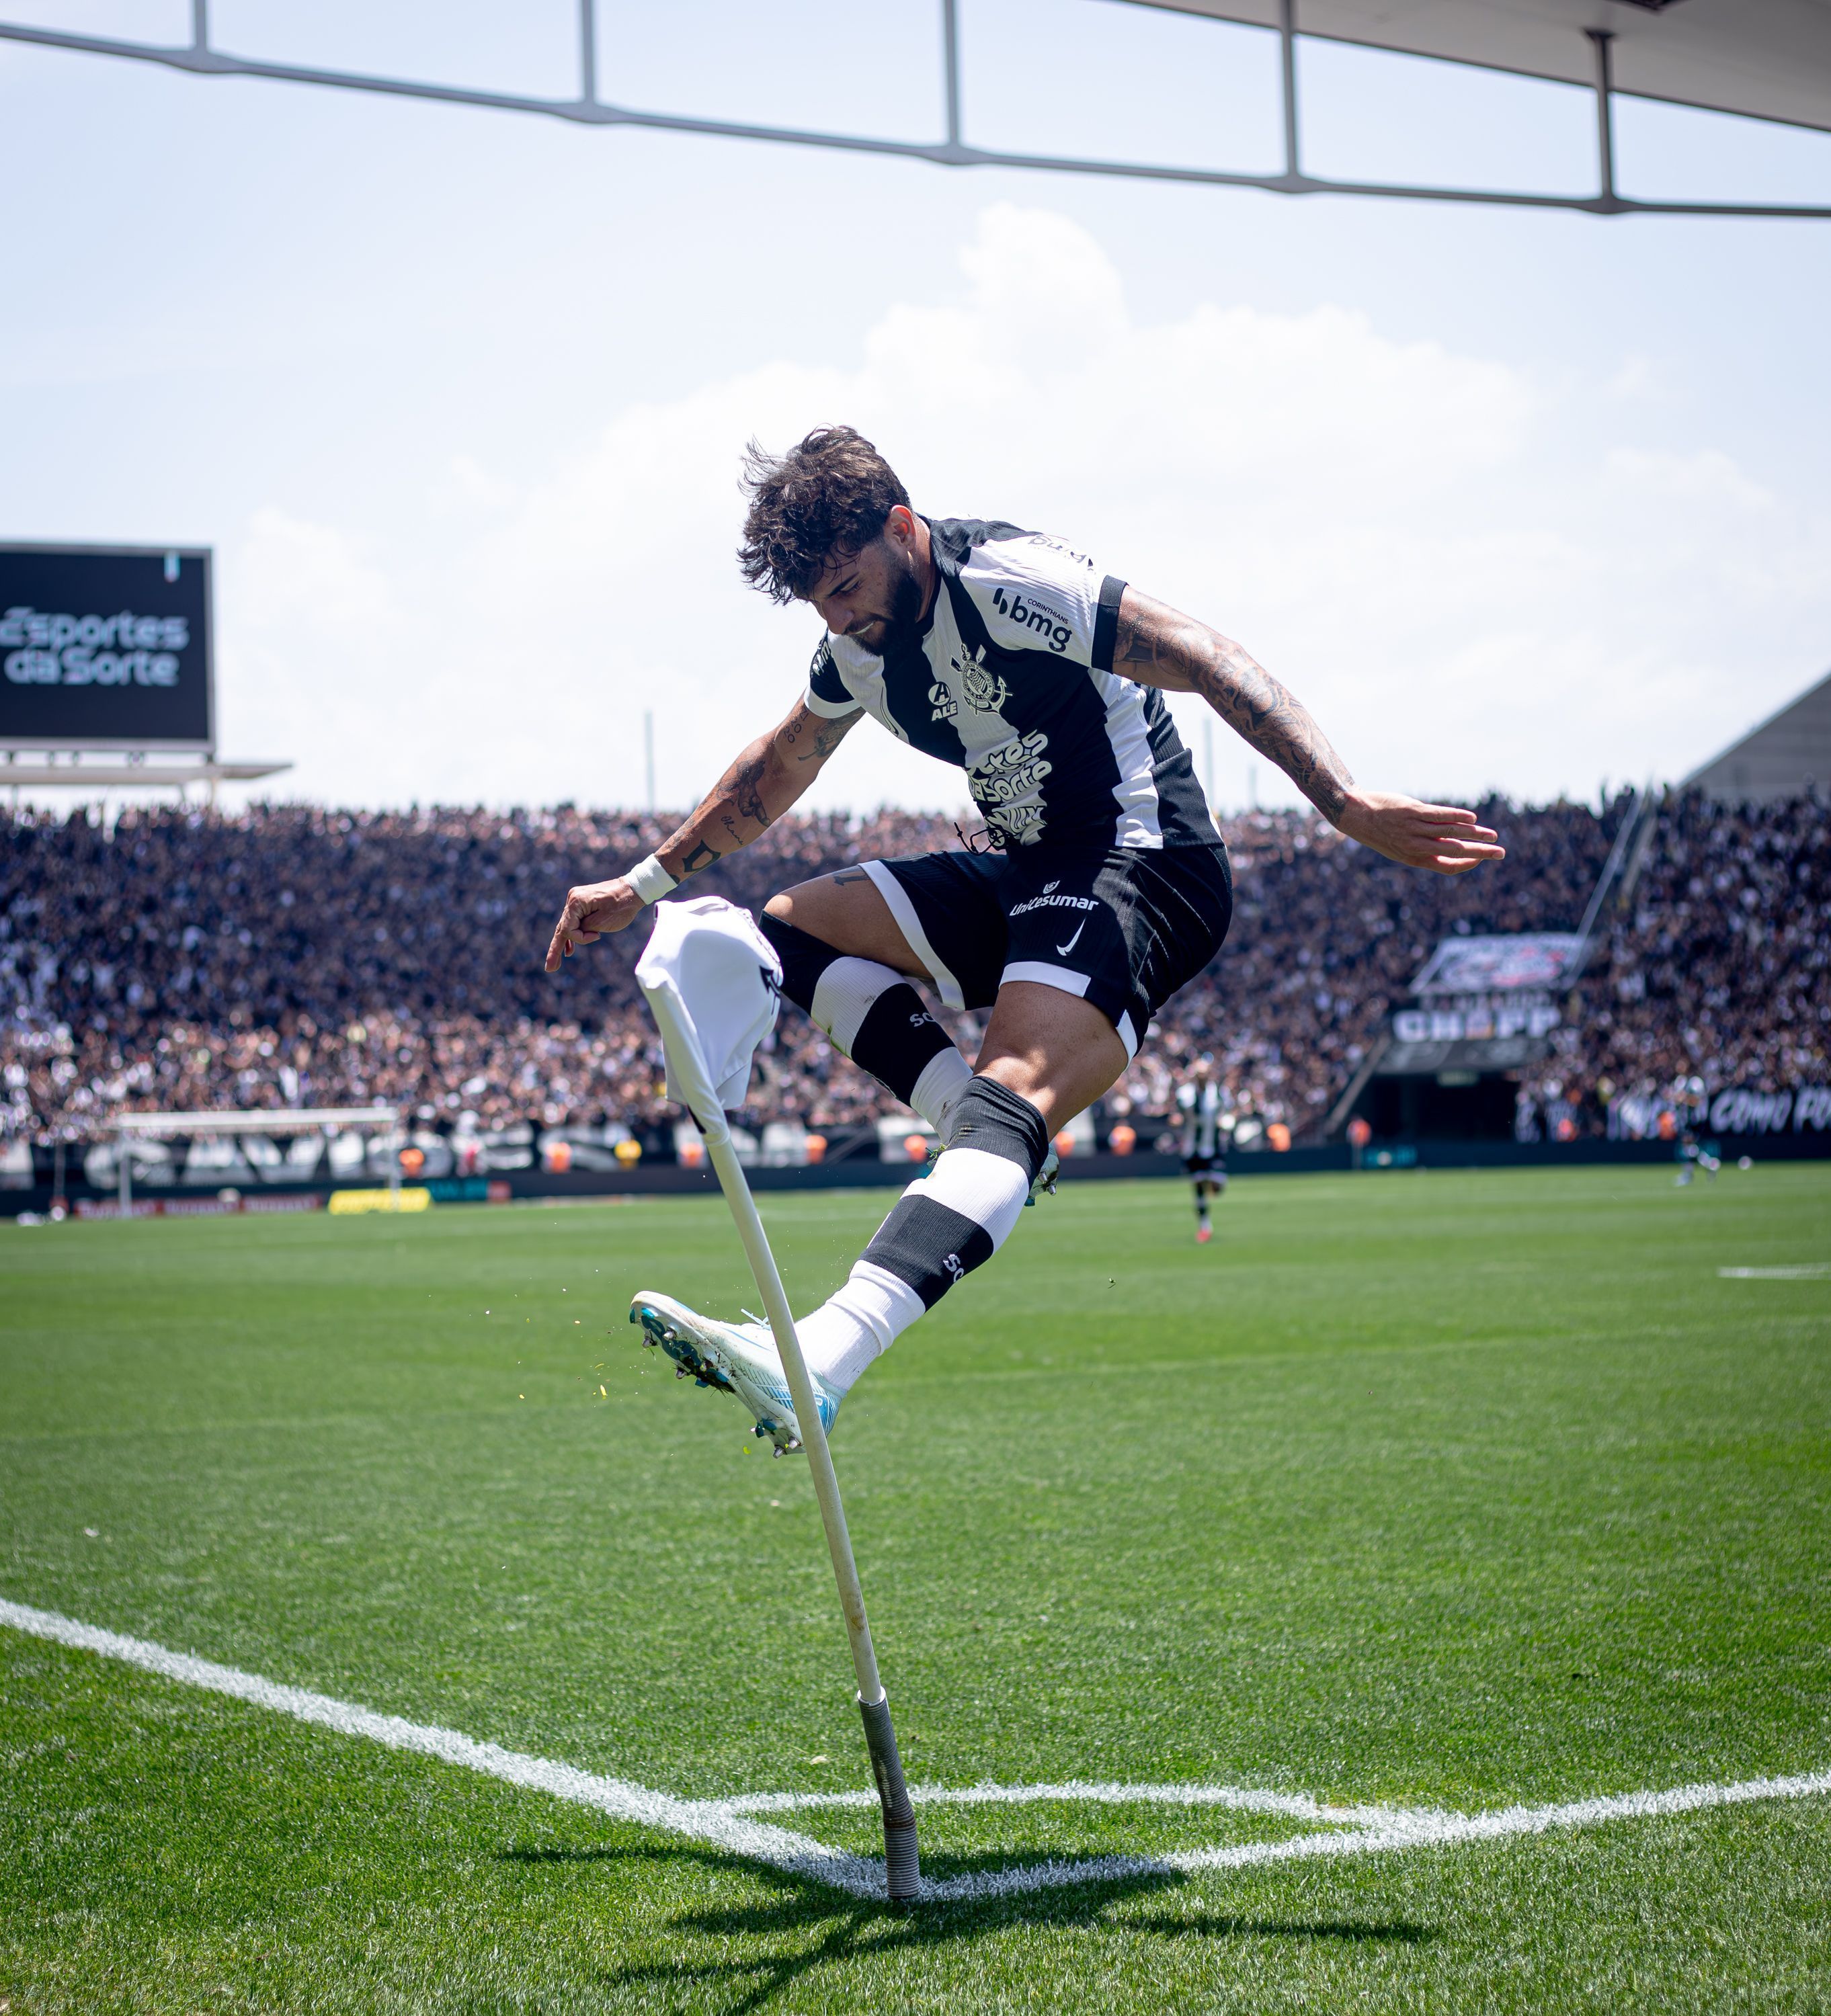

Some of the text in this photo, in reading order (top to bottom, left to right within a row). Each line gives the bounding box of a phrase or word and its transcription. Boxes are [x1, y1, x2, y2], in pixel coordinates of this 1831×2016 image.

[0, 606, 190, 650] Esportes
[1009, 595, 1072, 653] bmg
[1027, 598, 1069, 624] CORINTHIANS
[63, 646, 179, 686] Sorte
[932, 702, 957, 721] ALE
